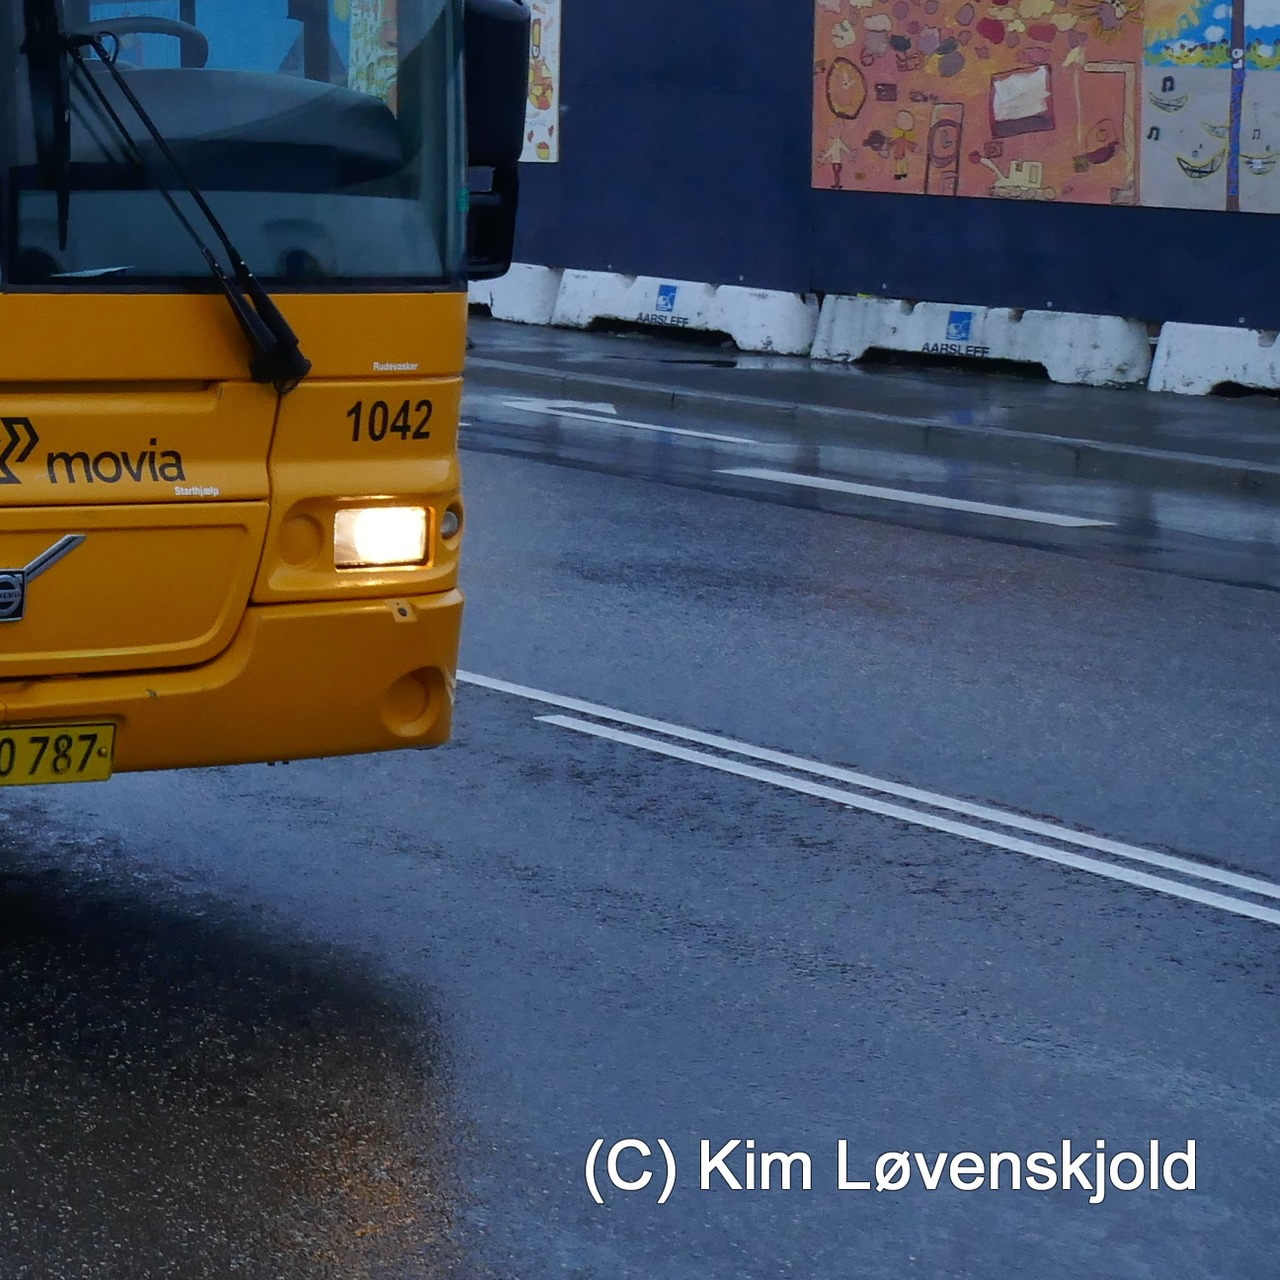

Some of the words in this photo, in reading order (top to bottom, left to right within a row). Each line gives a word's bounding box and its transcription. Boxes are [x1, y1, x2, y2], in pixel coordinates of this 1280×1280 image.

[635, 312, 690, 328] AARSLEFF
[921, 342, 991, 358] AARSLEFF
[346, 399, 433, 442] 1042
[46, 438, 187, 484] movia
[28, 733, 98, 776] 787
